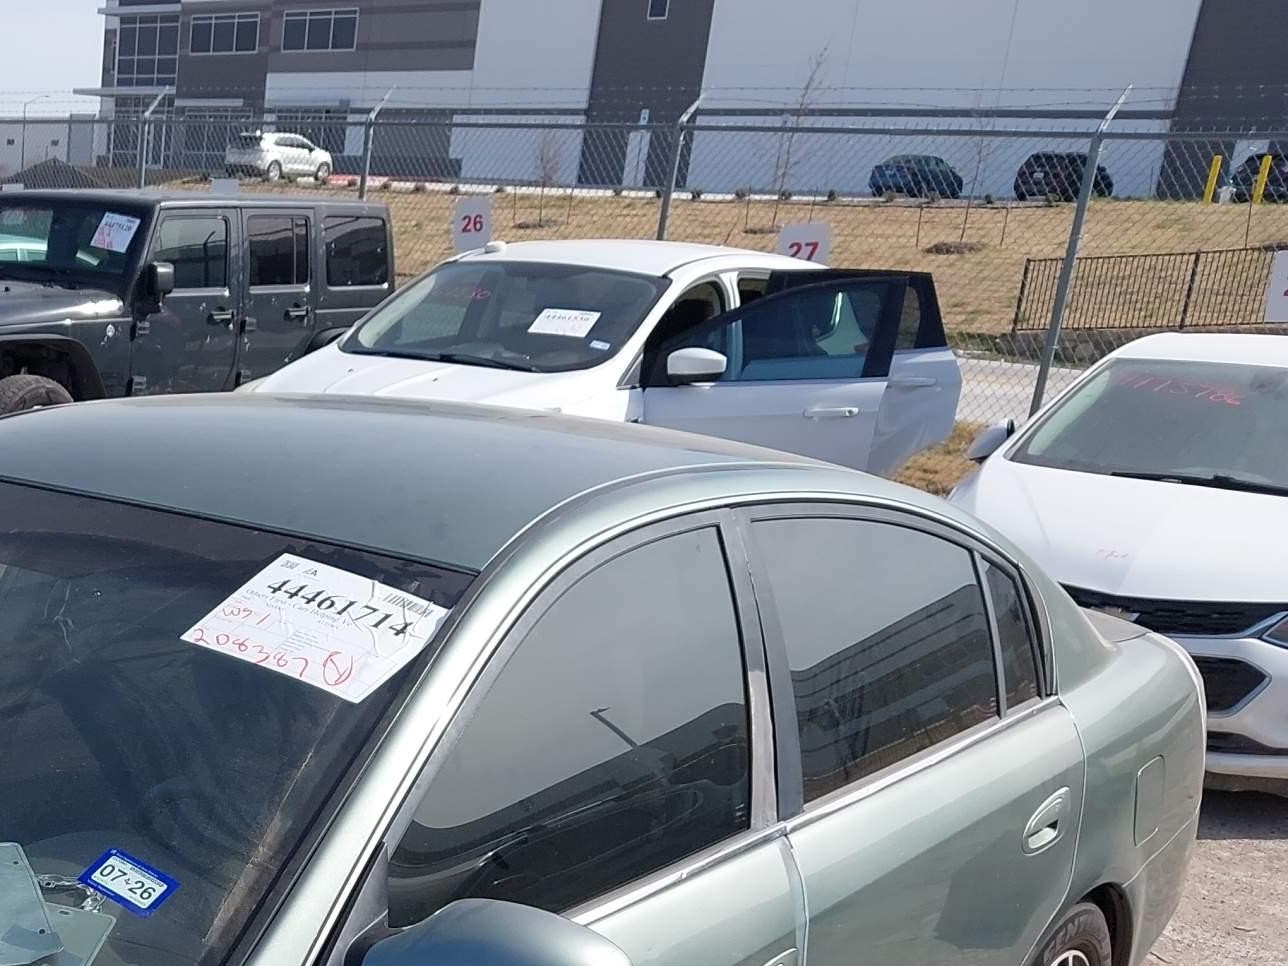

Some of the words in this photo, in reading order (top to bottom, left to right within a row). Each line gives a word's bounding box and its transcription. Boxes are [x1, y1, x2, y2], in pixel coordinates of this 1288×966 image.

[461, 214, 484, 234] 26
[788, 241, 819, 261] 27
[266, 579, 414, 638] 44461714
[99, 864, 128, 882] 07
[128, 879, 157, 901] 26
